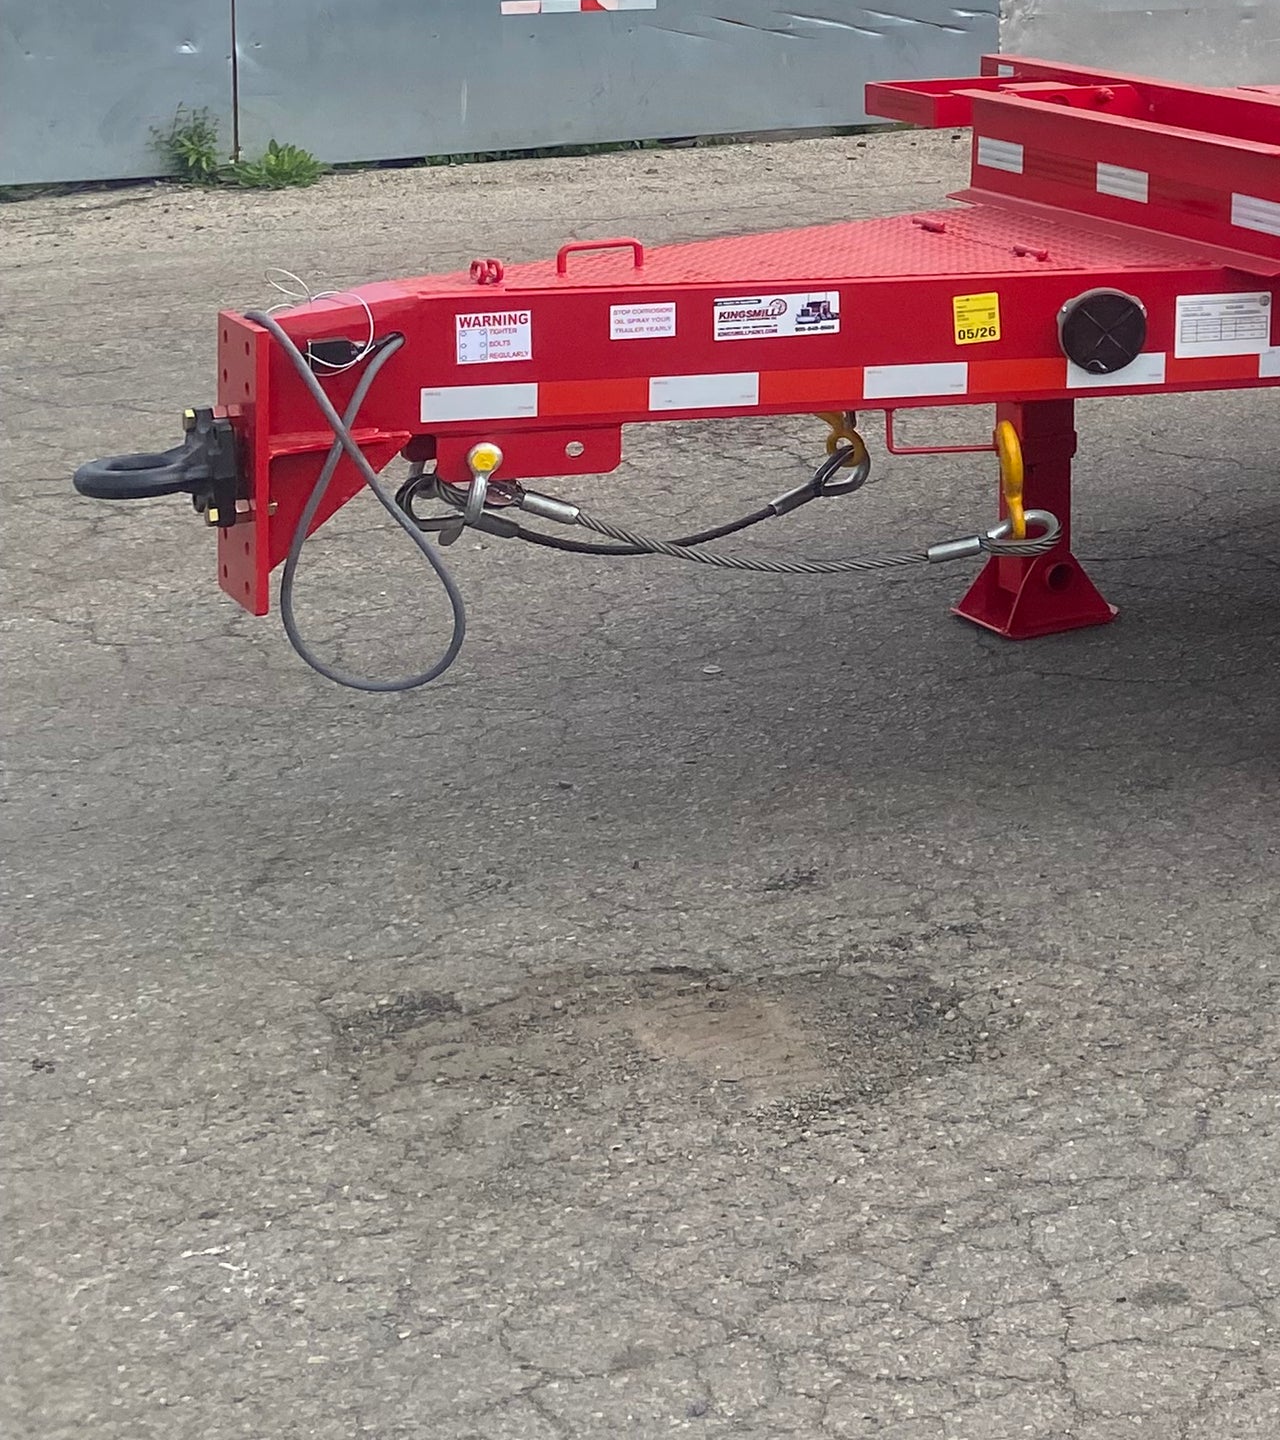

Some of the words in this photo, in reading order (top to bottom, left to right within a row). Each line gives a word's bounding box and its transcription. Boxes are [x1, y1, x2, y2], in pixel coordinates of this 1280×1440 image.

[458, 313, 529, 328] WARNING
[718, 308, 779, 320] KINGSMILL
[958, 326, 997, 340] 05/26
[489, 339, 511, 347] BOLTS
